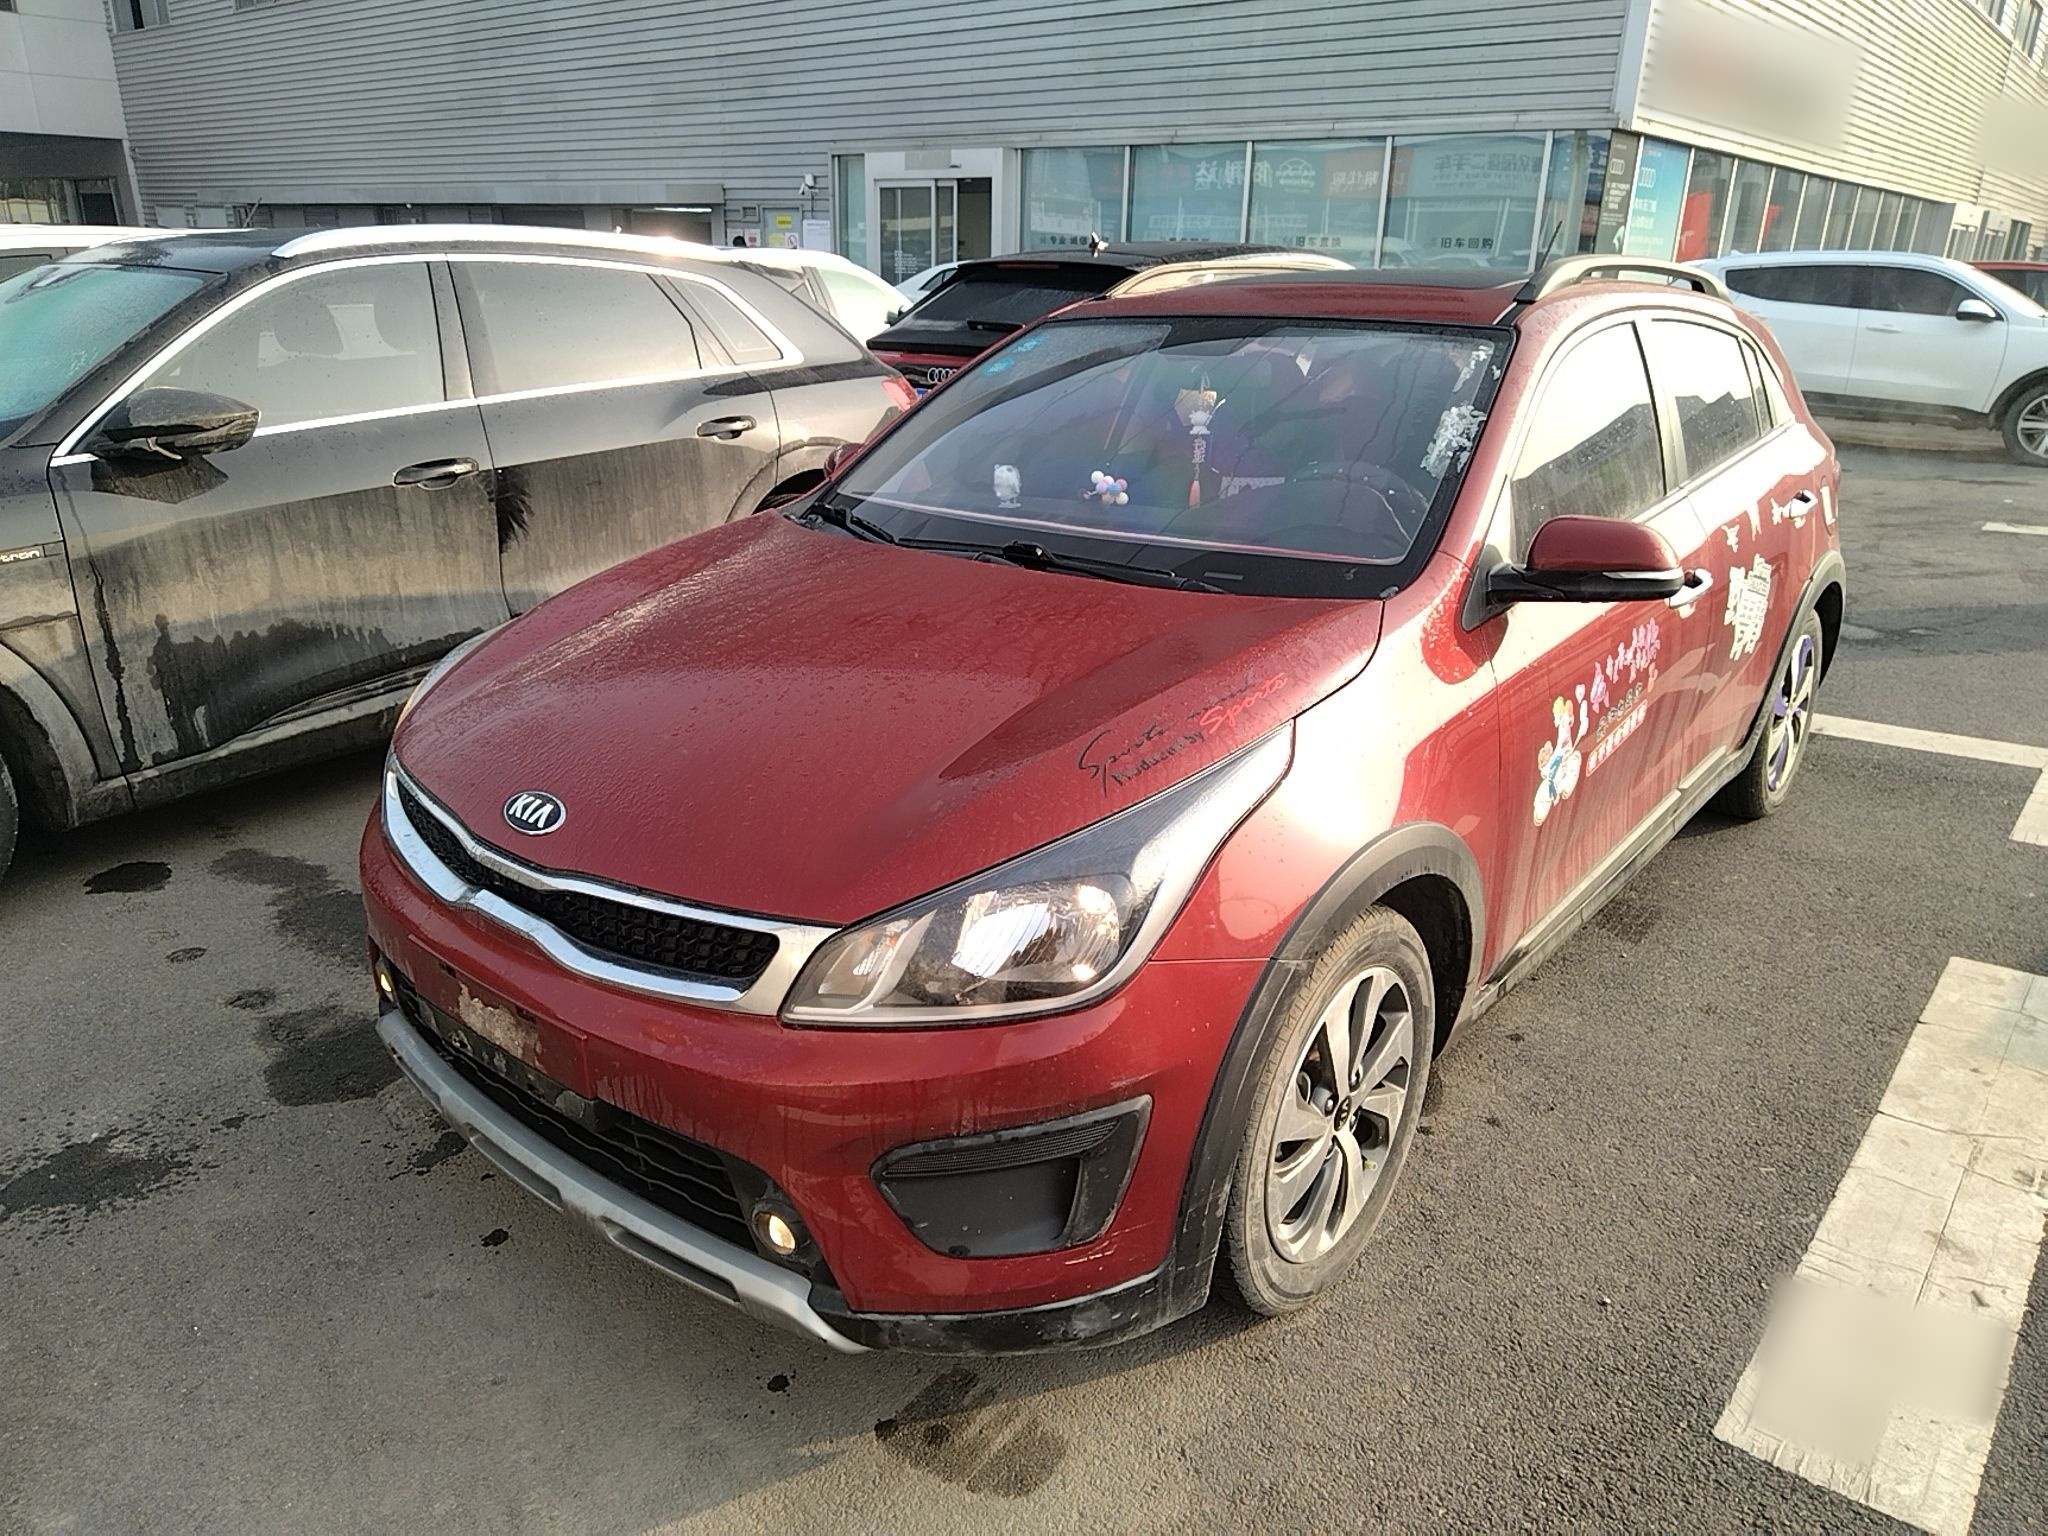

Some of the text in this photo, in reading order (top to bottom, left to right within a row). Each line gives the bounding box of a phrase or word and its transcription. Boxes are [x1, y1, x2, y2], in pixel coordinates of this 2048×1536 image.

[1440, 236, 1494, 250] 旧车回购
[1199, 671, 1289, 734] Sports
[507, 793, 555, 829] KIA
